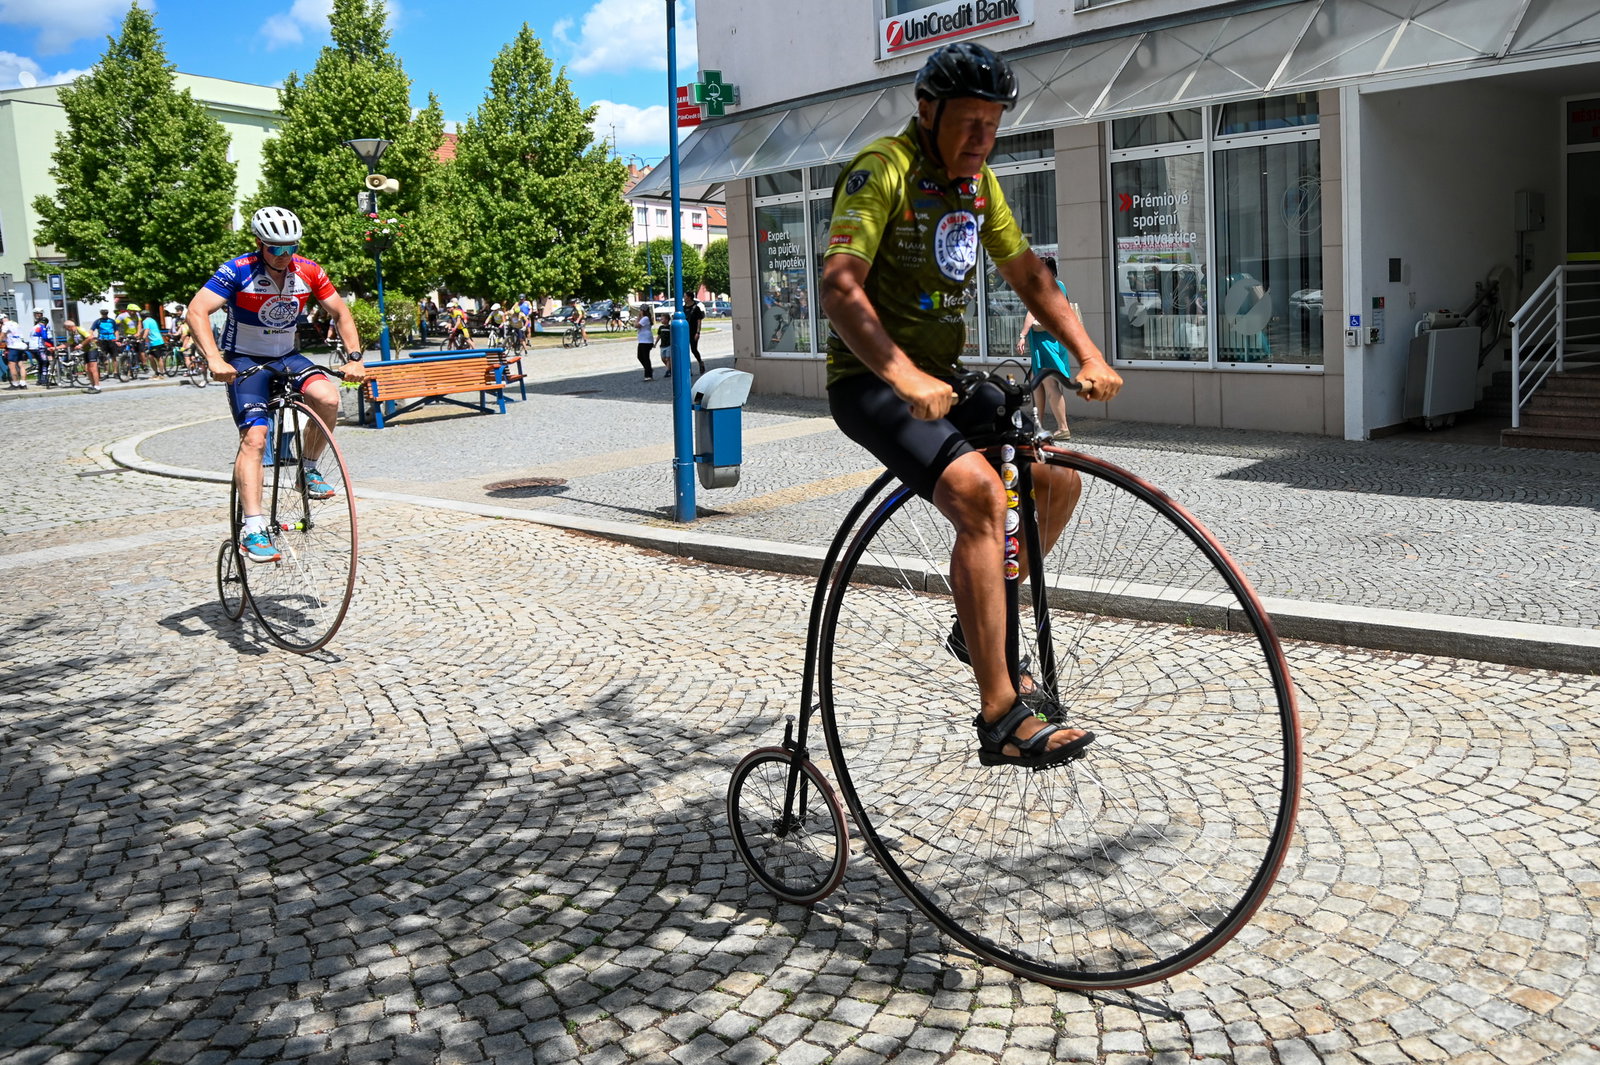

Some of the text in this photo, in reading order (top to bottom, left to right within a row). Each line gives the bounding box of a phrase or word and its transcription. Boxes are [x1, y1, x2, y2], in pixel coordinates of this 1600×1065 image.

[904, 0, 1019, 42] UniCredit Bank
[1132, 189, 1189, 209] Prémiové
[1133, 210, 1178, 230] spoření
[767, 230, 790, 243] Expert
[1134, 234, 1140, 246] a
[1143, 229, 1197, 246] investice
[768, 243, 800, 257] na půjčky
[769, 256, 806, 271] a hypotéky
